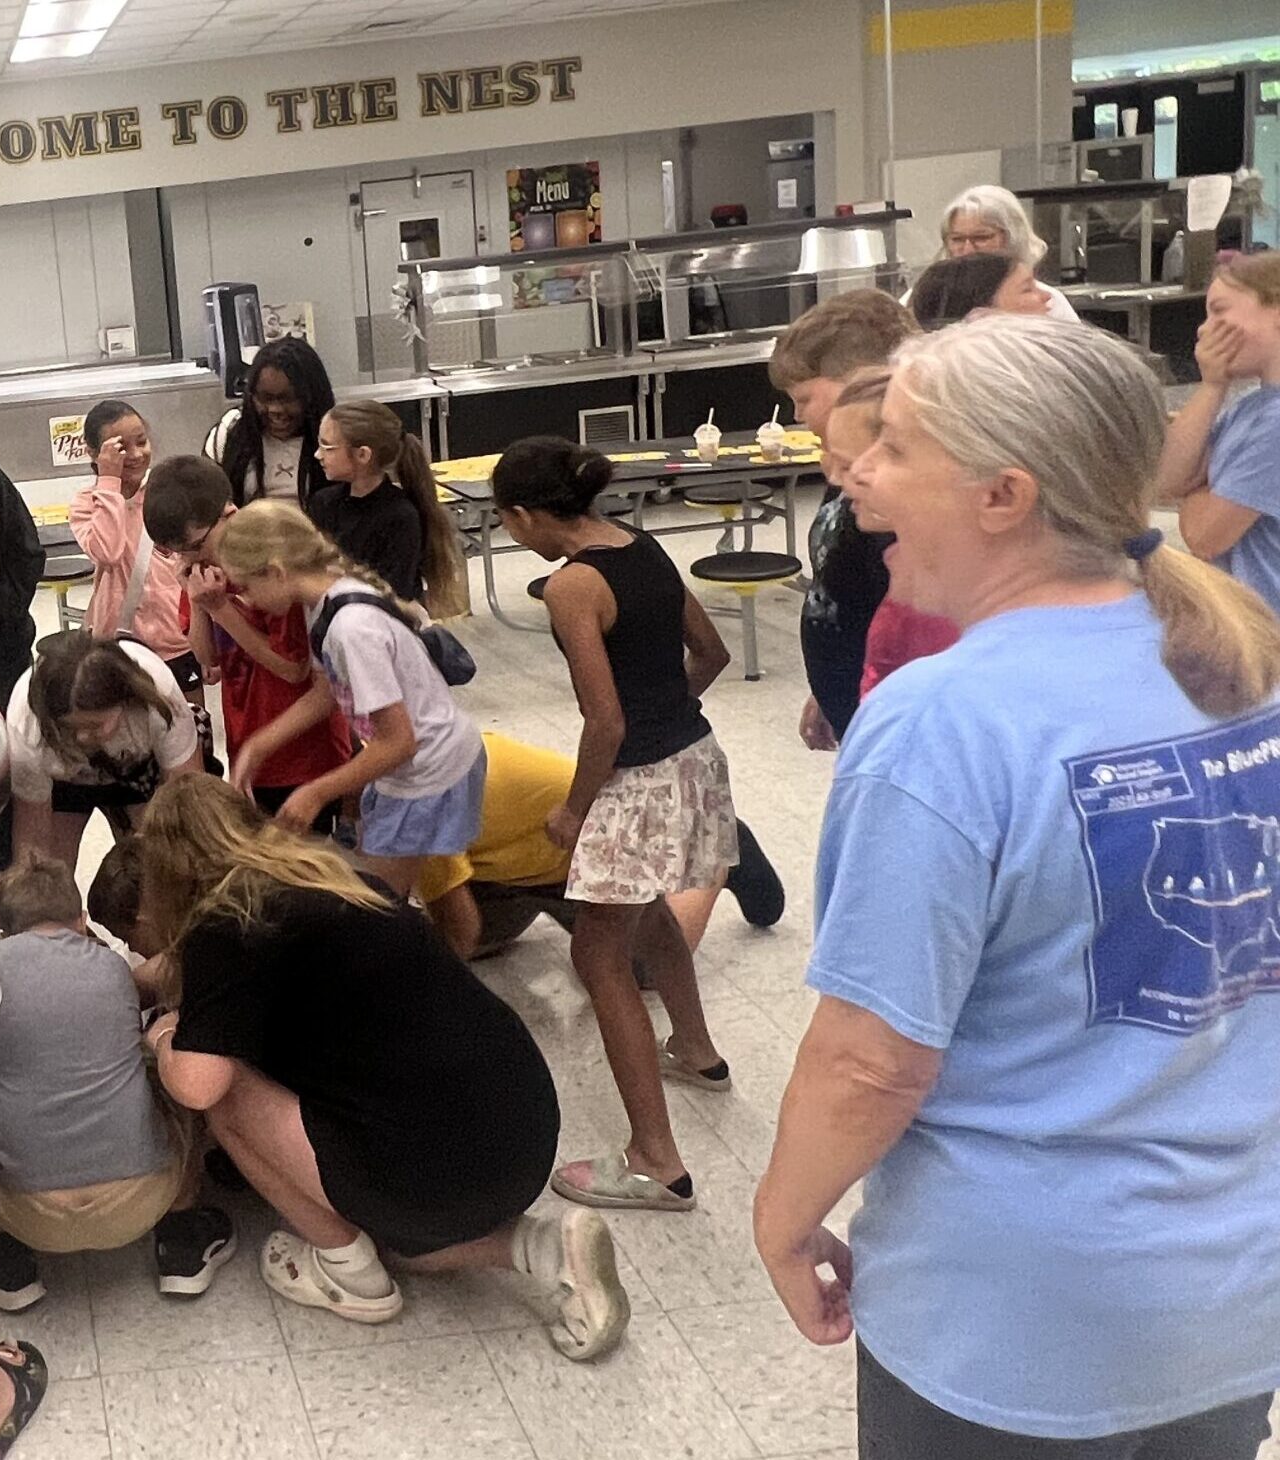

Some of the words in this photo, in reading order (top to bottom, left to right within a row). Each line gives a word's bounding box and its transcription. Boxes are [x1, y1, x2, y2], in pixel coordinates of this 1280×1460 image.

[160, 96, 248, 146] TO
[267, 77, 398, 133] THE
[417, 57, 583, 117] NEST
[535, 180, 570, 204] Menu
